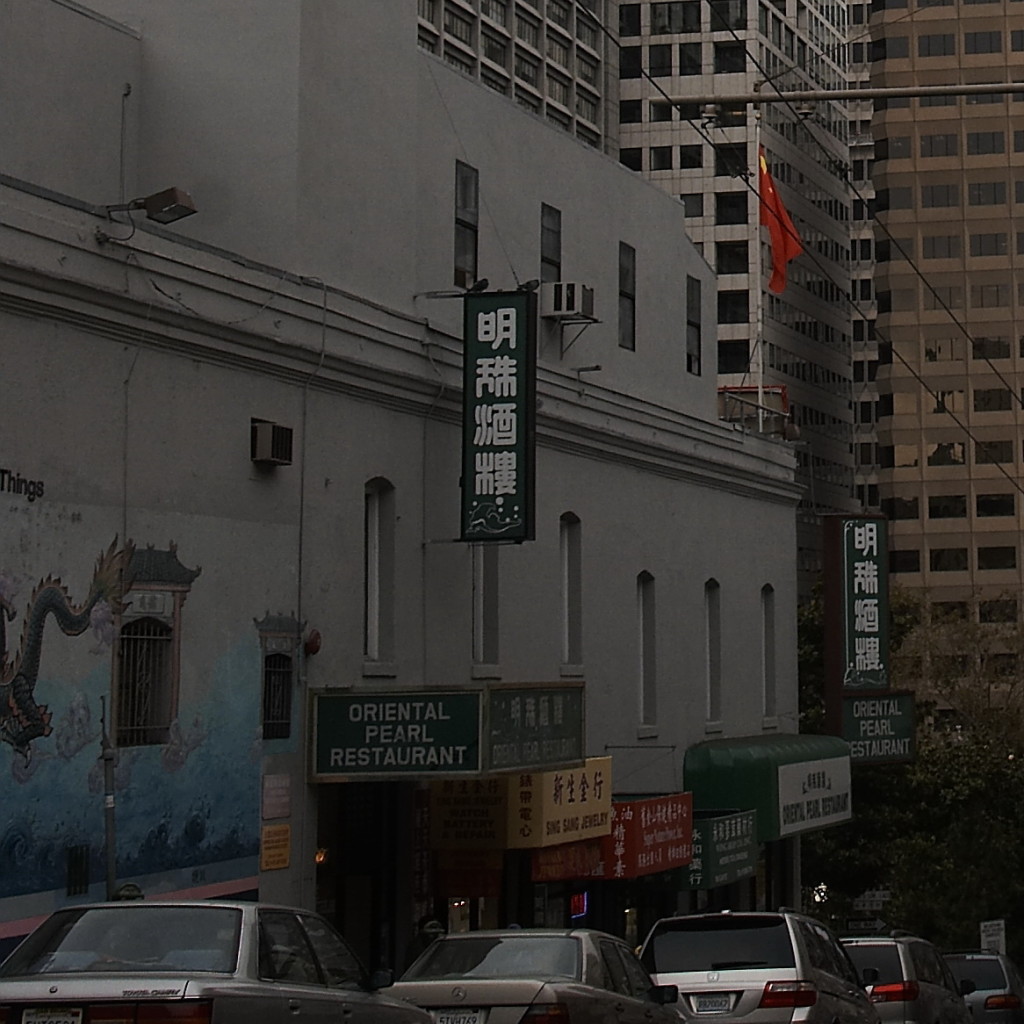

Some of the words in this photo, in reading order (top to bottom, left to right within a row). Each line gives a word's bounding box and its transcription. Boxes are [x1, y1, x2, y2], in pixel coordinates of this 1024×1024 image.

[473, 307, 518, 496] 明珠酒樓
[0, 469, 44, 502] Things
[349, 702, 450, 722] ORIENTAL
[853, 699, 902, 718] ORIENTAL
[365, 724, 434, 744] PEARL
[860, 719, 895, 736] PEARL
[330, 746, 467, 767] RESTAURANT
[849, 737, 911, 758] ESTAURANT
[449, 808, 489, 817] WATCH
[443, 820, 495, 829] BATTERY
[546, 820, 560, 836] SING
[563, 817, 579, 833] SANG
[581, 812, 608, 830] JEWELRY
[455, 830, 496, 839] REPAIR
